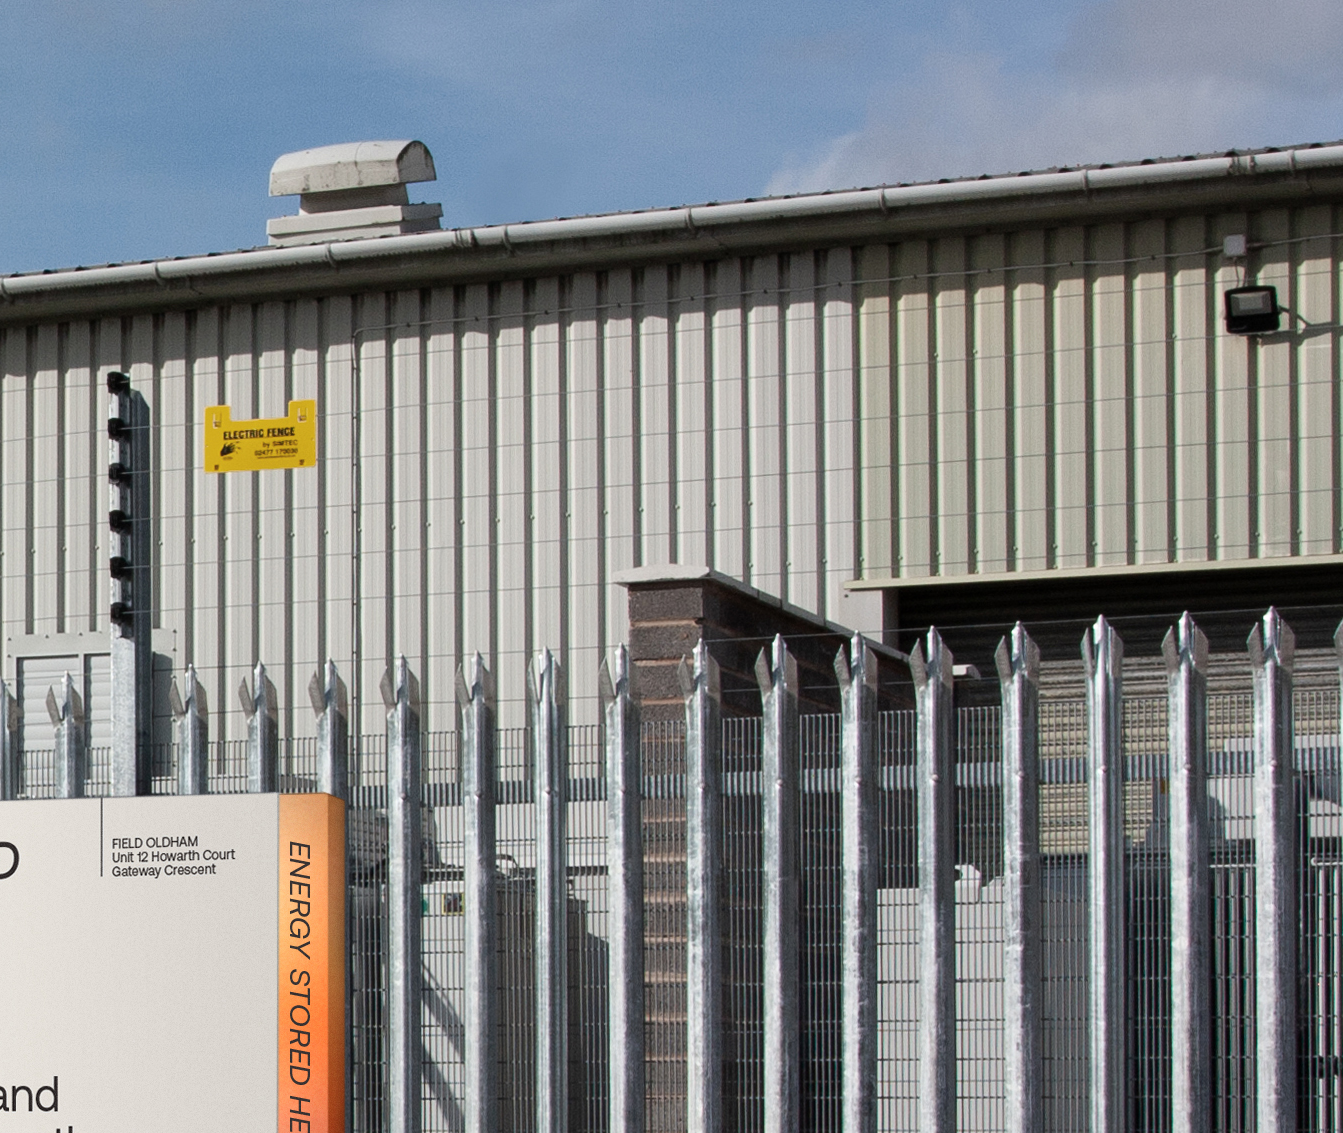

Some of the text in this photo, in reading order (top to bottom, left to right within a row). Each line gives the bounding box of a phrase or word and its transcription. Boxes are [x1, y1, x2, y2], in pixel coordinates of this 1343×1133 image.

[223, 427, 295, 440] ELECTRIC FENCE
[112, 836, 199, 849] FIELD OLDHAM
[112, 848, 236, 863] Unit 12 Howarth Court
[111, 863, 217, 879] Gateway Crescent
[289, 841, 311, 960] ENERGY
[289, 968, 311, 1086] STORED
